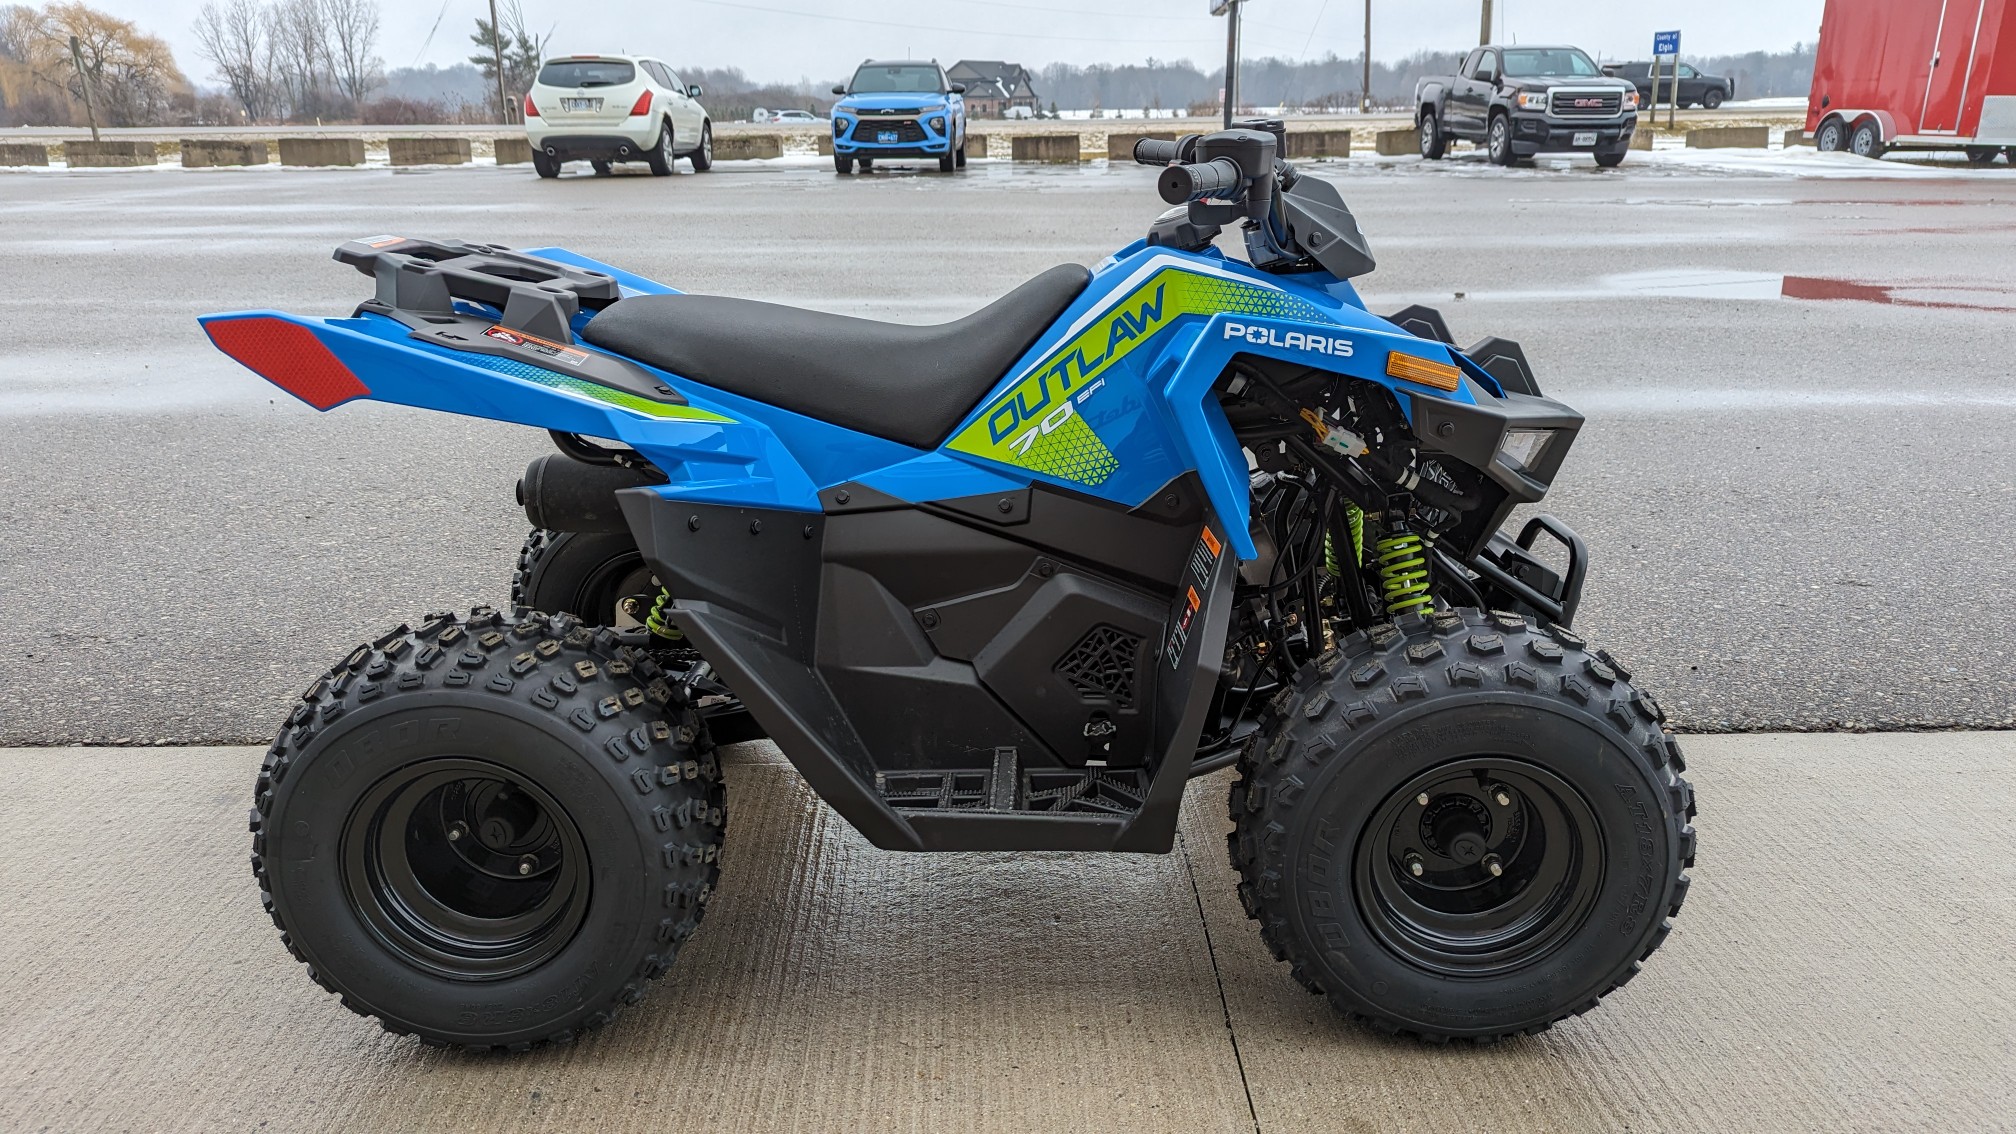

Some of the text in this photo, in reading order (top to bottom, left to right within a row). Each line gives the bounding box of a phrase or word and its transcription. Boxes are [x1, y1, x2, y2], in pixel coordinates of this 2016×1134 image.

[1659, 43, 1673, 52] Elgin
[1574, 99, 1603, 107] GMC
[1223, 322, 1354, 357] POLARIS
[988, 282, 1166, 446] OUTLAW
[1008, 401, 1074, 459] 70
[1077, 378, 1105, 405] EFI
